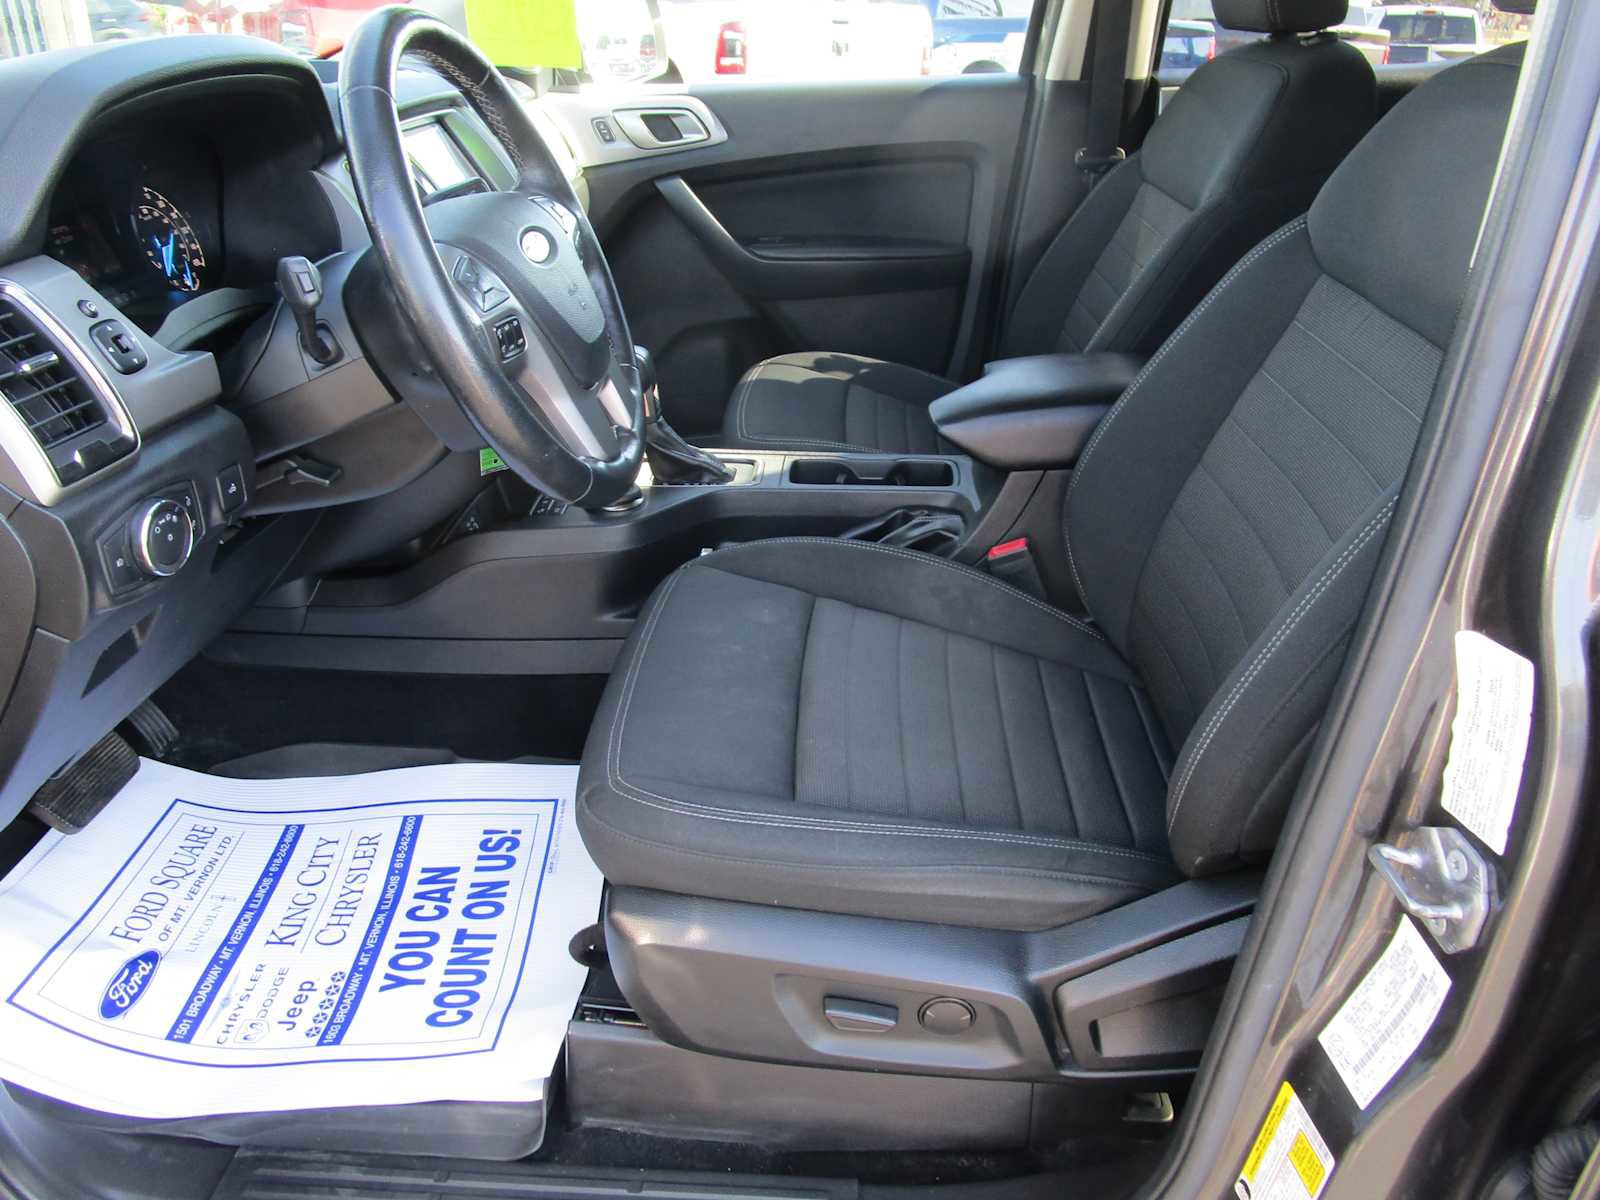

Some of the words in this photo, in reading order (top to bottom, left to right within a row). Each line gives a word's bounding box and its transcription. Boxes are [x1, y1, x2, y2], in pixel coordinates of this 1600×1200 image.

[109, 891, 169, 944] FORD
[150, 823, 218, 890] SQUARE
[264, 892, 318, 947] KING
[297, 836, 340, 887] CITY
[314, 832, 383, 946] CHRYSLER
[474, 829, 523, 872] US!
[158, 924, 173, 942] OF
[184, 856, 219, 901] VERNON
[405, 866, 461, 922] CAN
[461, 880, 511, 920] ON
[109, 960, 153, 1008] Ford
[173, 1019, 193, 1039] 1501
[186, 964, 223, 1017] BROADWAY
[249, 877, 273, 909] ILLINOIS
[333, 972, 363, 1023] BROADWAY
[381, 875, 400, 910] ILLINOIS
[378, 930, 441, 992] YOU
[425, 928, 498, 1028] COUNT
[216, 963, 266, 1045] CHRYSLER
[256, 967, 290, 1018] DODGE
[277, 980, 317, 1031] Jeep
